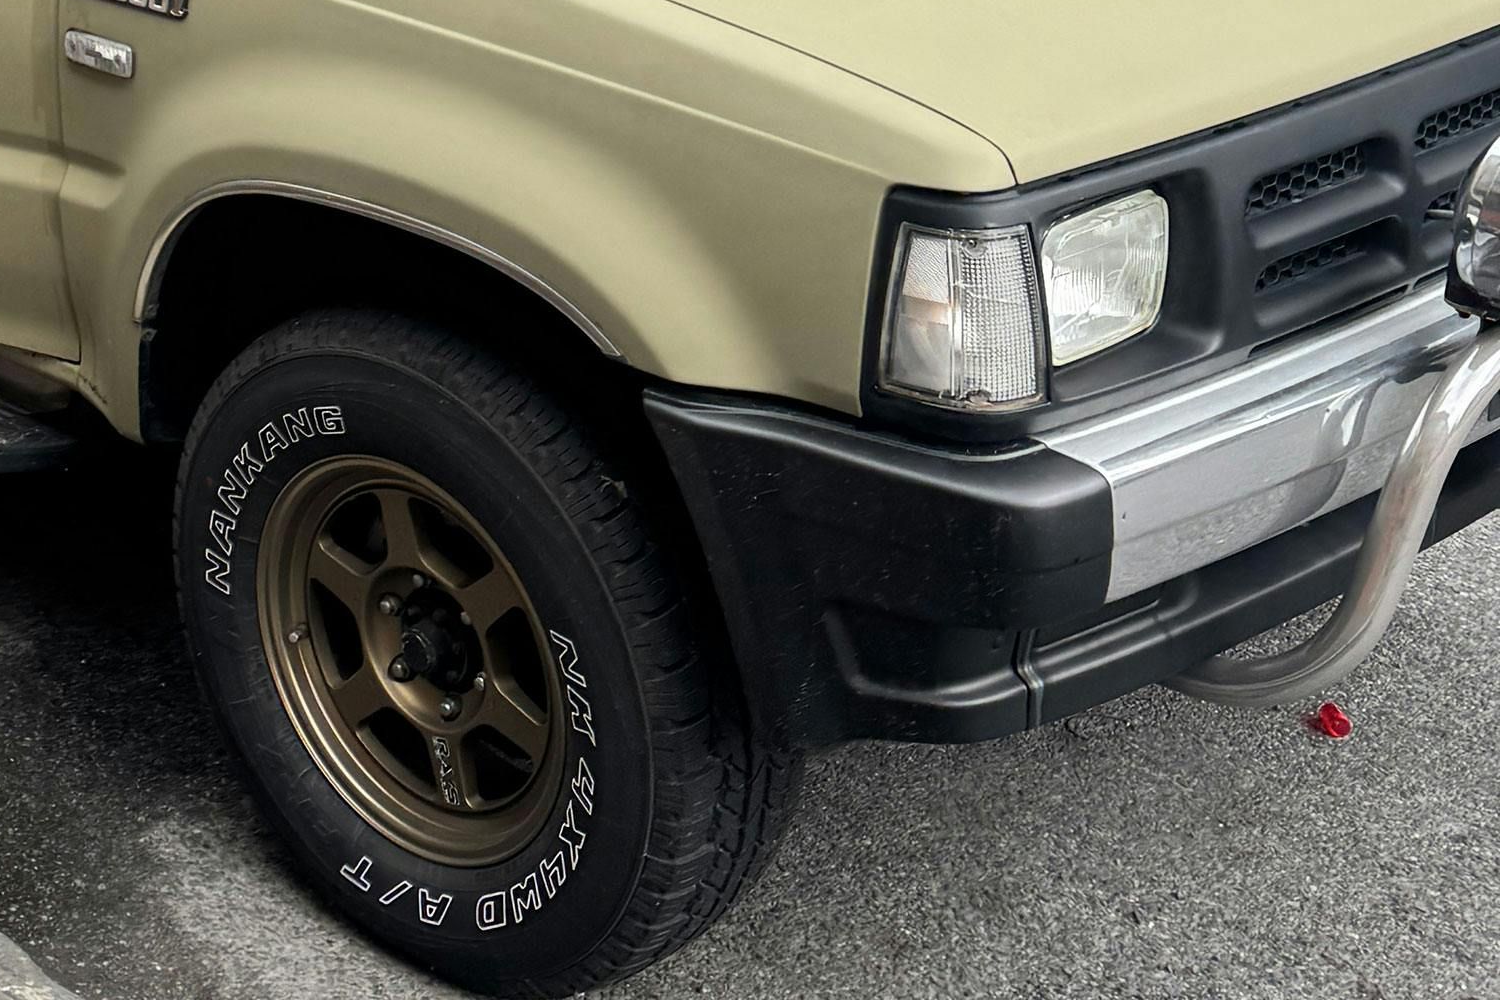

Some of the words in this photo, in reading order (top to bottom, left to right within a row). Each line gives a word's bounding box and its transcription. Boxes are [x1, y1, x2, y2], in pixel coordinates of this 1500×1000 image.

[205, 406, 346, 595] NANKANG
[550, 629, 597, 747] NK
[340, 856, 453, 926] A/T
[475, 757, 595, 931] 4X4WD
